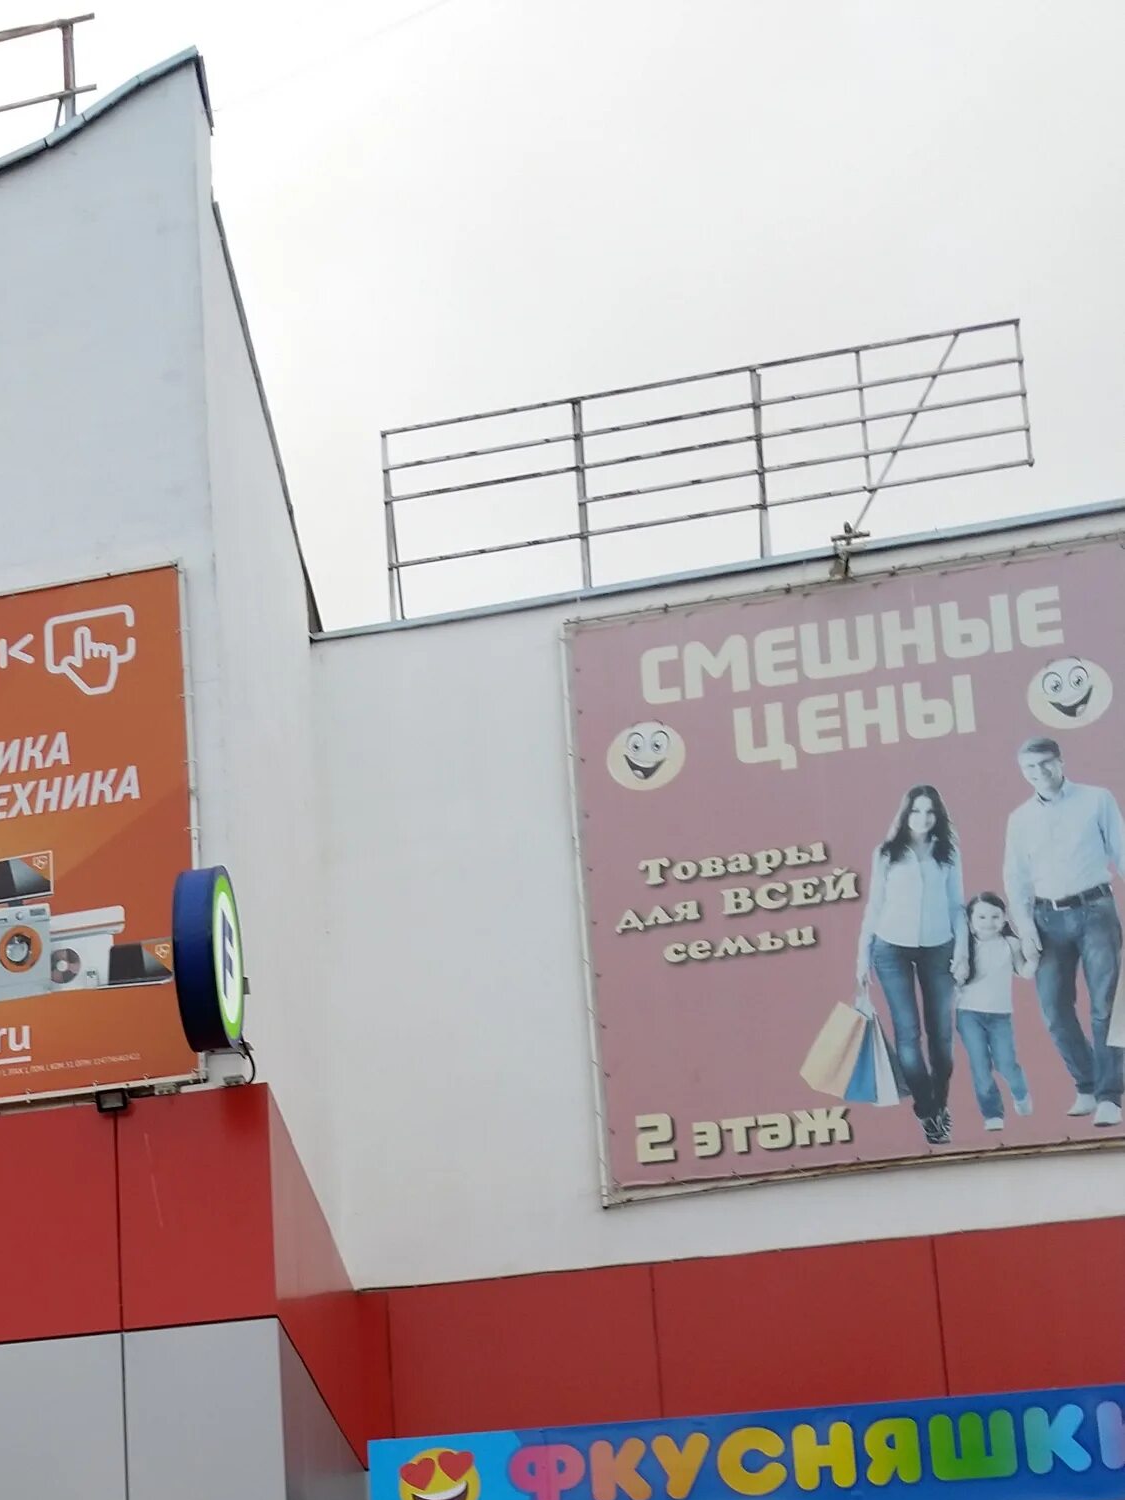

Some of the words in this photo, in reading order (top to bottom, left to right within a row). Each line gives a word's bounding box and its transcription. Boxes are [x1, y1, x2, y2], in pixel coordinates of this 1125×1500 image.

[640, 585, 1064, 706] СМЕШНЫЕ
[732, 674, 976, 770] ЦЕНЫ
[637, 841, 829, 887] Товары
[615, 900, 701, 936] для
[720, 868, 860, 918] ВСЕЙ
[662, 925, 817, 965] семьи
[635, 1112, 679, 1165] 2
[691, 1106, 854, 1159] этаж
